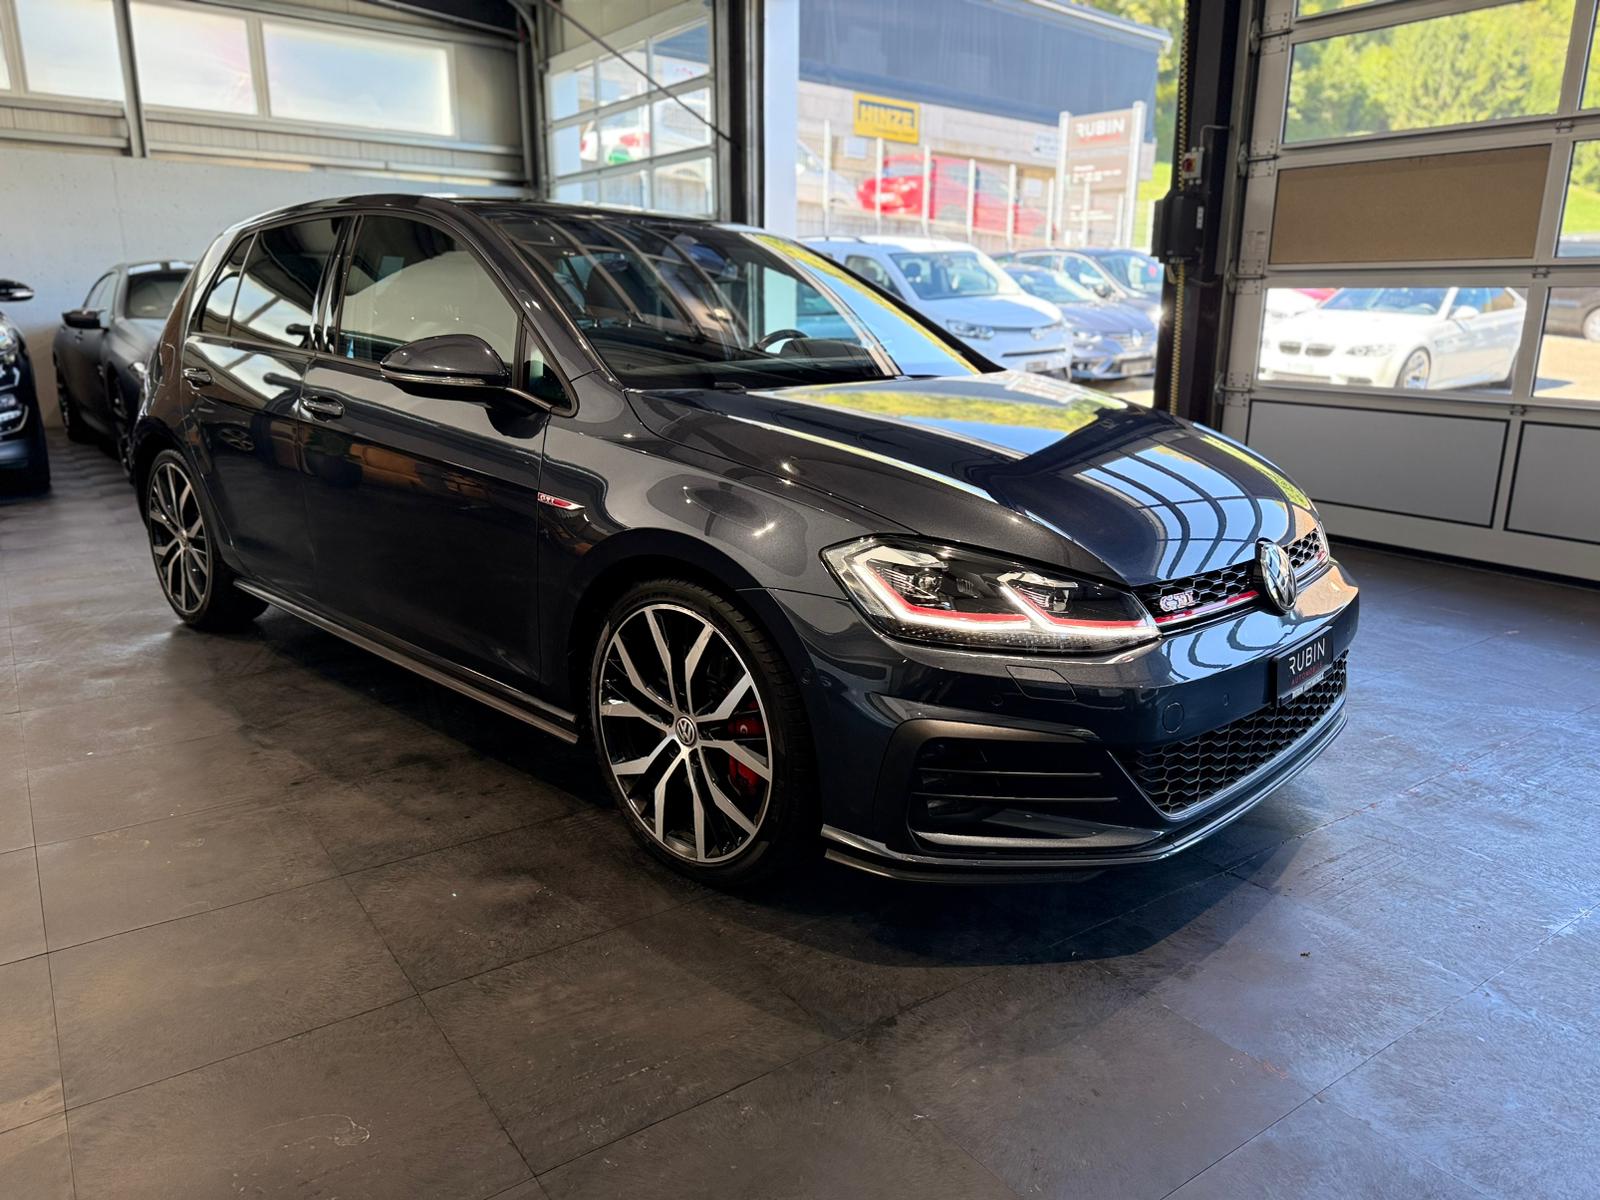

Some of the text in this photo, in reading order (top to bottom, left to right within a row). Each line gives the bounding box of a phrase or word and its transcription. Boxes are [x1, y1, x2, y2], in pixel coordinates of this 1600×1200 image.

[1074, 117, 1125, 137] RUBIN
[1160, 590, 1194, 612] GTI
[1288, 637, 1325, 675] RUBIN
